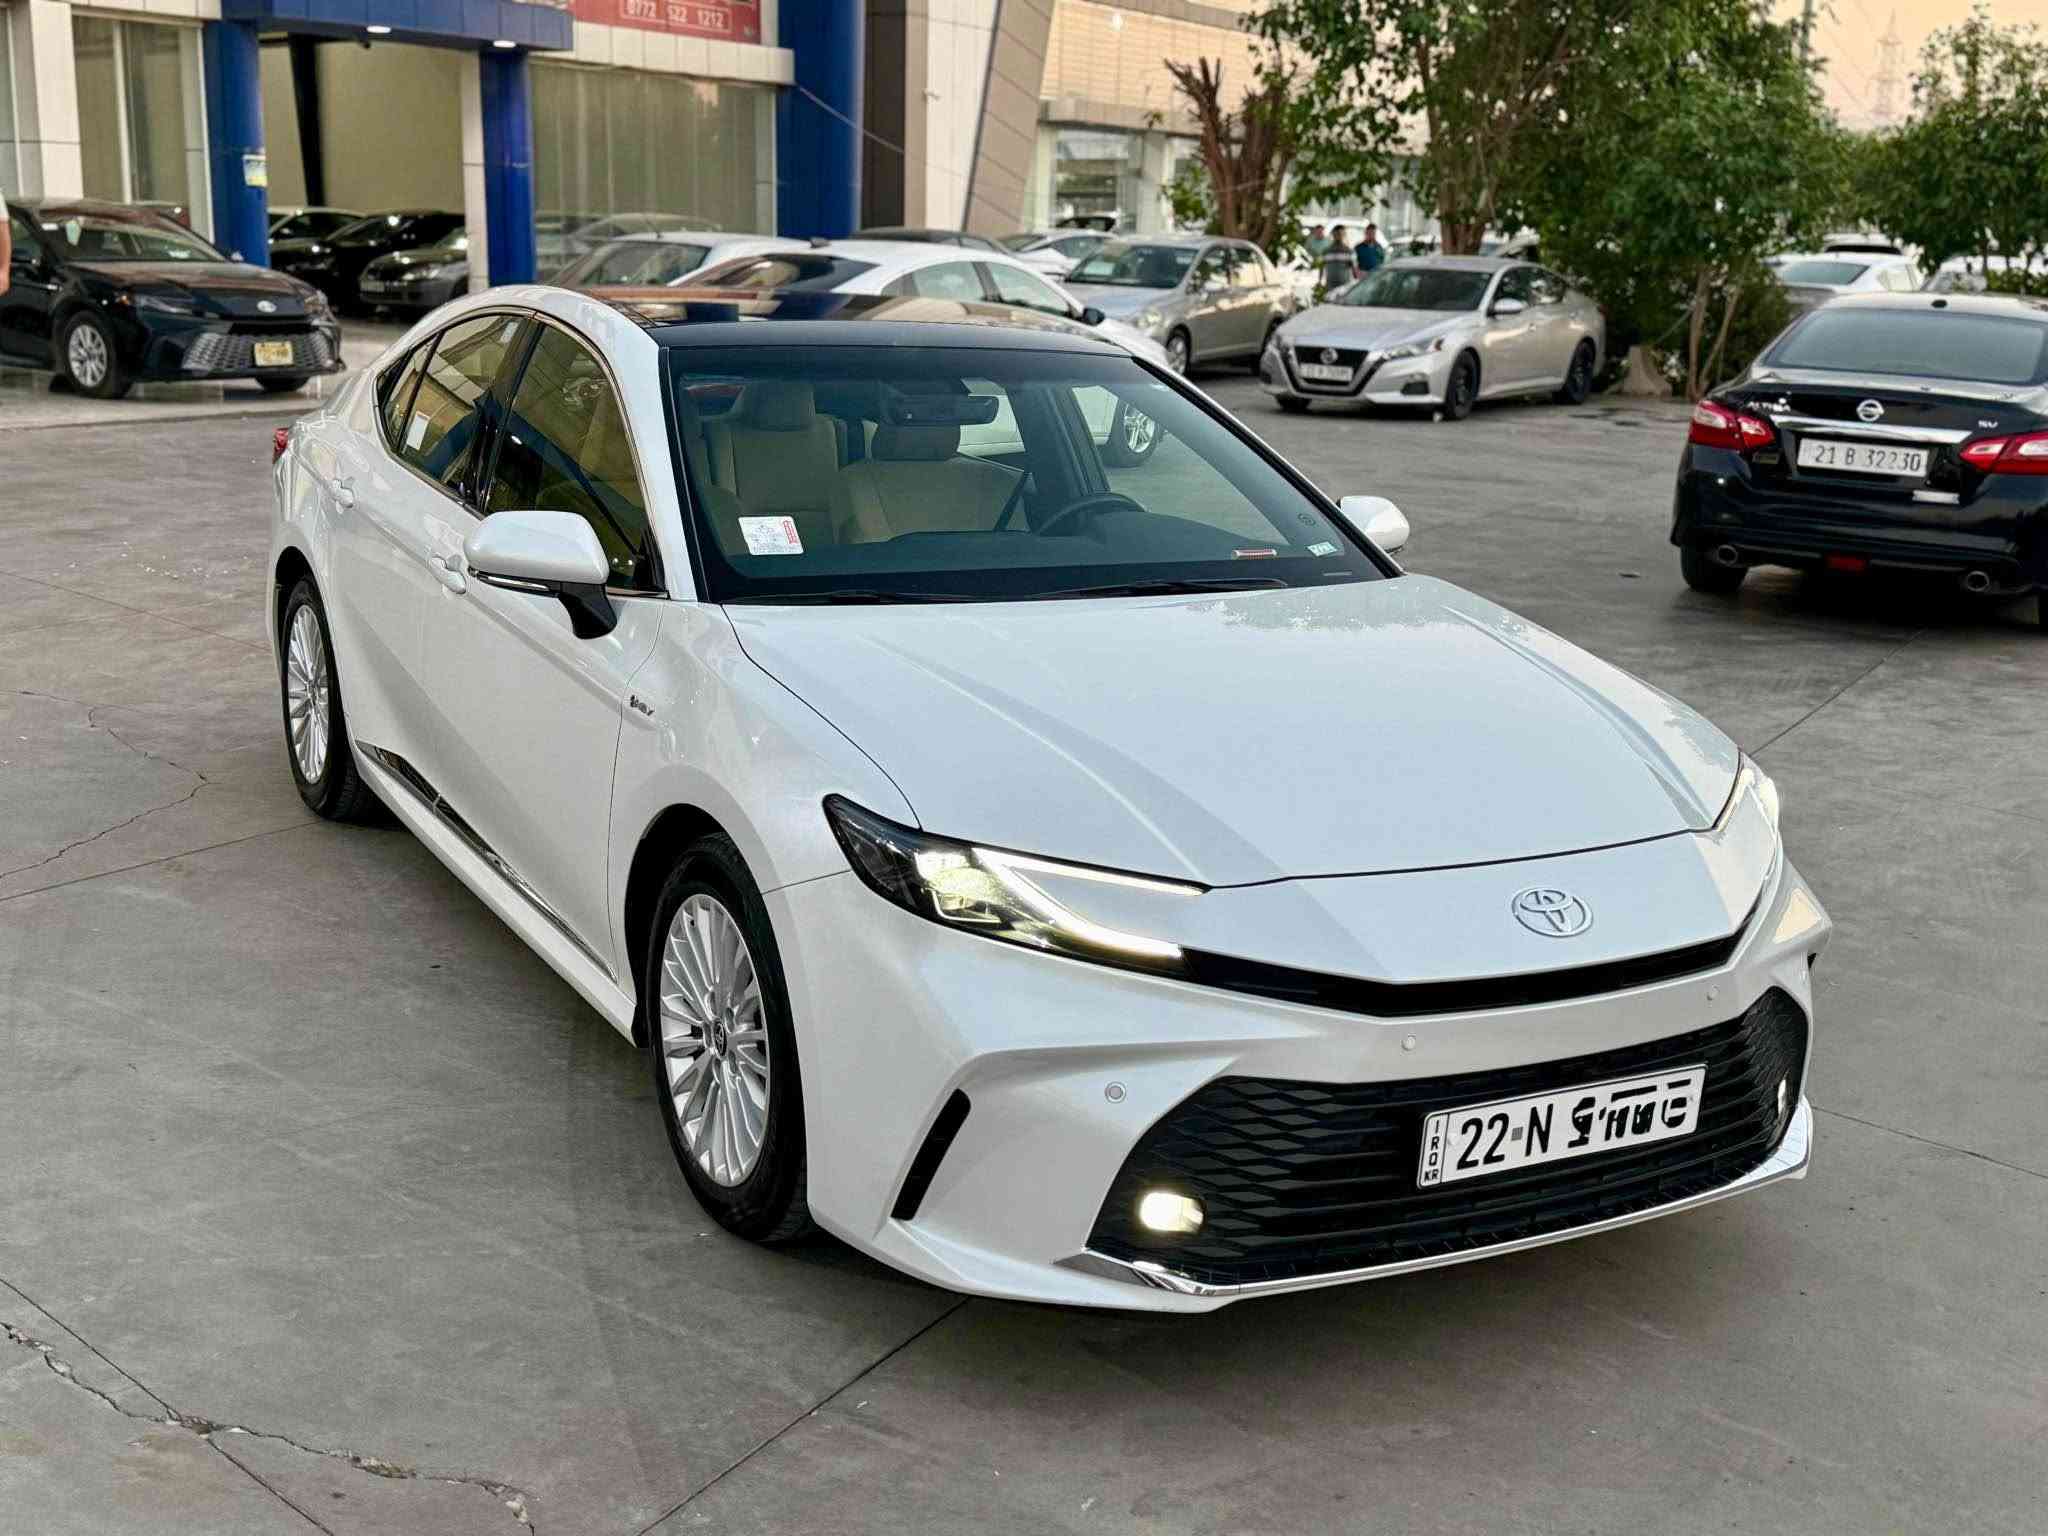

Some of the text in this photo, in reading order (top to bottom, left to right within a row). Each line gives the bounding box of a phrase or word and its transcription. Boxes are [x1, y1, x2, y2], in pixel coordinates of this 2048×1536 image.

[1815, 445, 1836, 465] 21
[1456, 1112, 1510, 1170] 22
[1525, 1103, 1554, 1157] N
